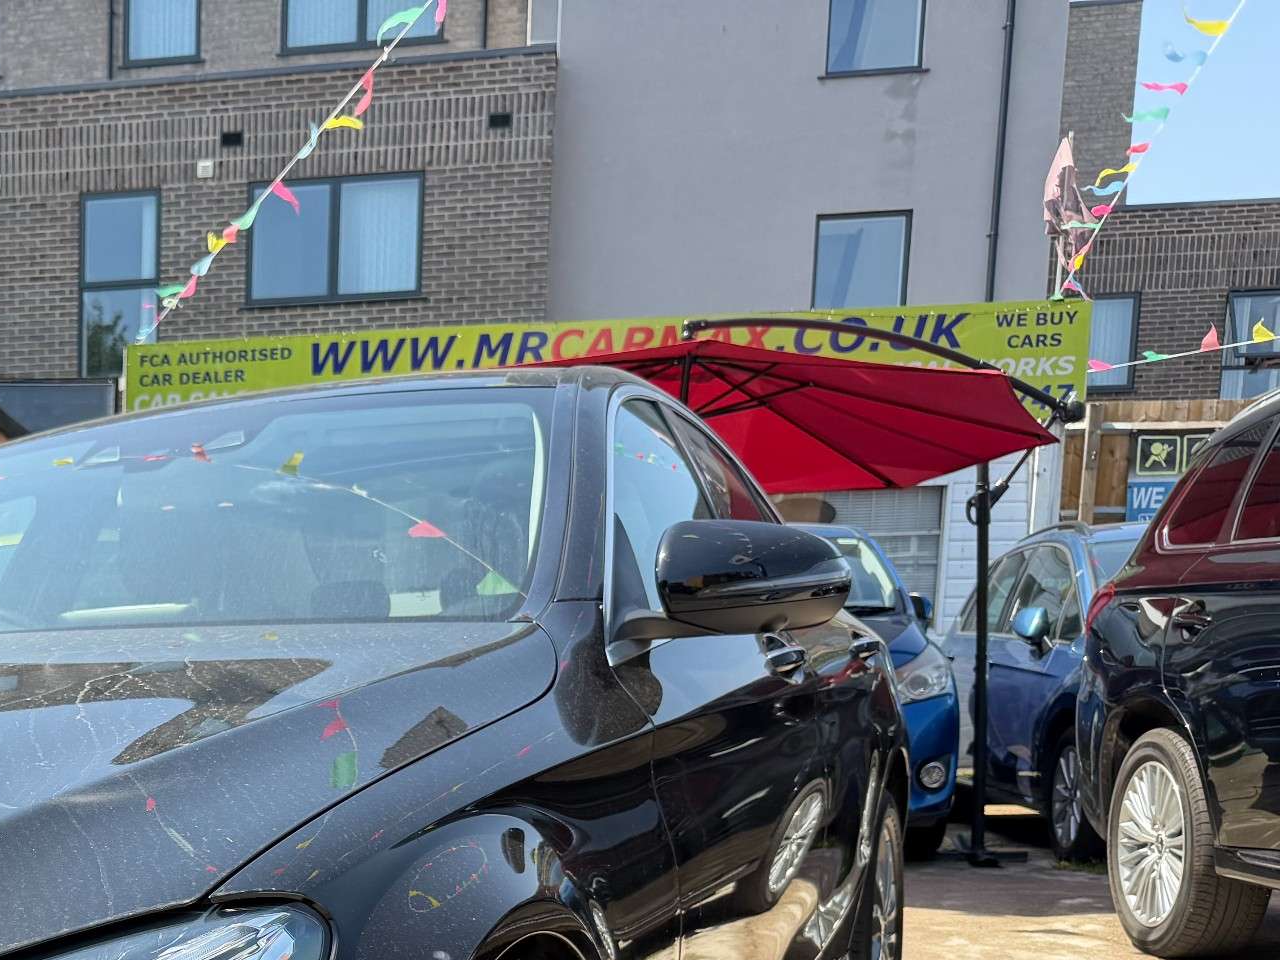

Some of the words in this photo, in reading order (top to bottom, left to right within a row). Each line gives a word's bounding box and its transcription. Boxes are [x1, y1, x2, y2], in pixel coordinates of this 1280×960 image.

[996, 313, 1028, 328] WE
[1036, 311, 1078, 326] BUY
[1007, 333, 1063, 348] CARS
[139, 354, 171, 368] FCA
[177, 347, 292, 366] AUTHORISED
[986, 356, 1076, 377] ORKS
[139, 372, 173, 387] CAR
[179, 369, 246, 385] DEALER
[1132, 486, 1166, 510] WE
